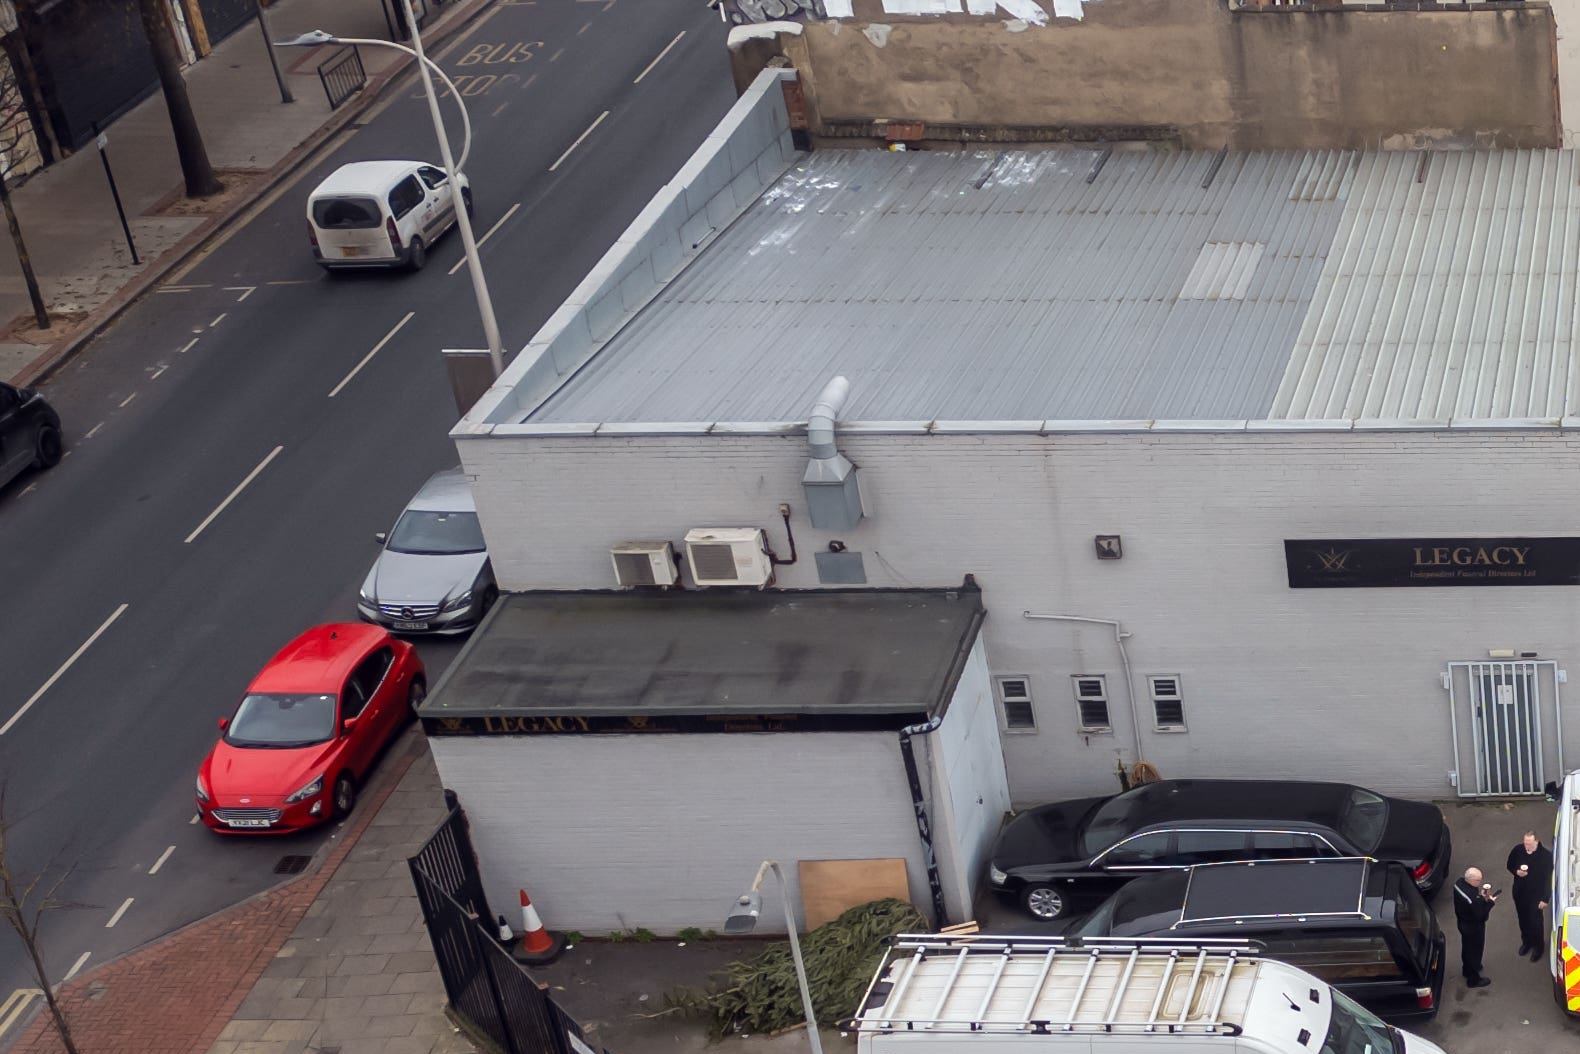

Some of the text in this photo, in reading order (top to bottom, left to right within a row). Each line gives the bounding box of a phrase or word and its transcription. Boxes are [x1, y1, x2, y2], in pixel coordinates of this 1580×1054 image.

[456, 41, 545, 66] BUS
[1413, 546, 1531, 565] LEGACY
[484, 715, 592, 732] LEGACY
